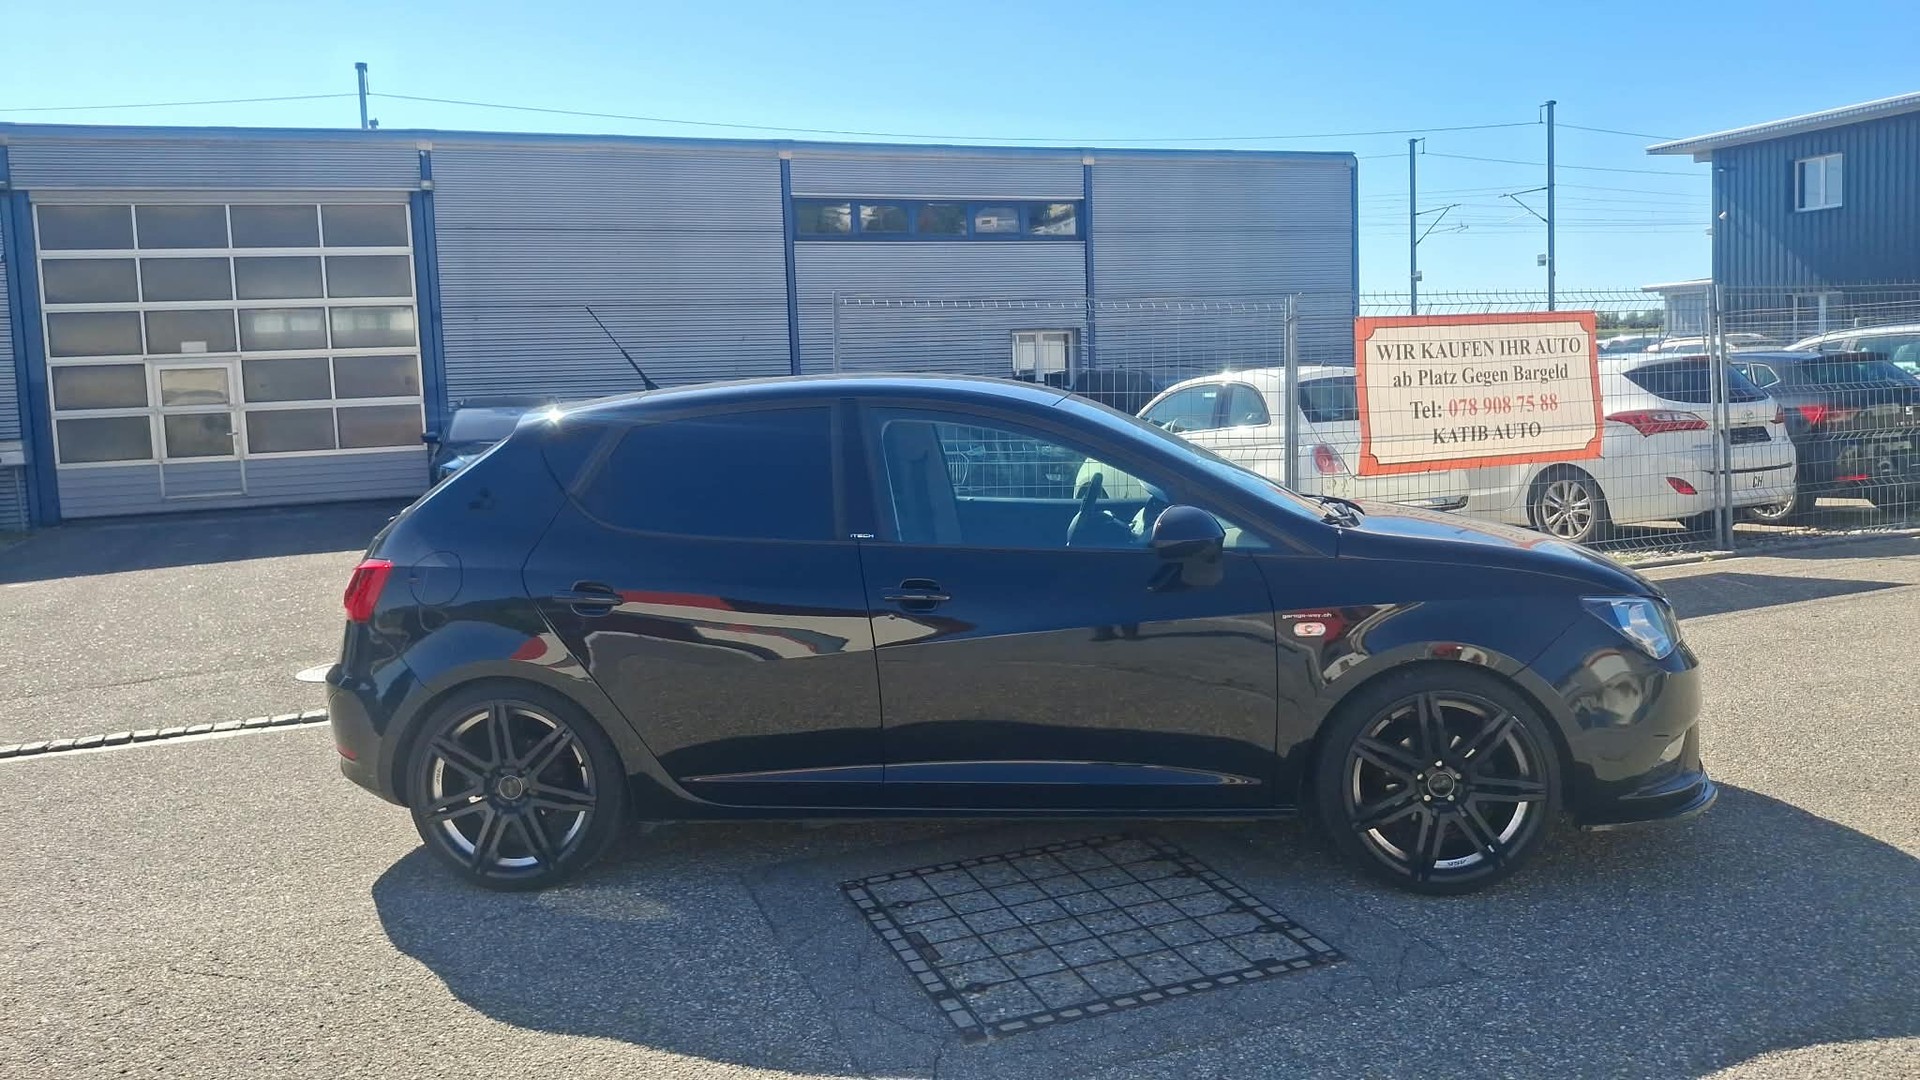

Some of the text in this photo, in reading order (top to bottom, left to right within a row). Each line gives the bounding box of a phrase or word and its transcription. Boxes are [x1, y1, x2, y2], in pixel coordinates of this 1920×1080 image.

[1376, 337, 1581, 361] WIR KAUFEN IHR AUTO
[1393, 363, 1569, 388] ab Platz Gegen Bargeld
[1410, 393, 1558, 419] Tel: 078 908 75 88
[1433, 421, 1541, 445] KATIB AUTO
[1752, 475, 1764, 488] CH
